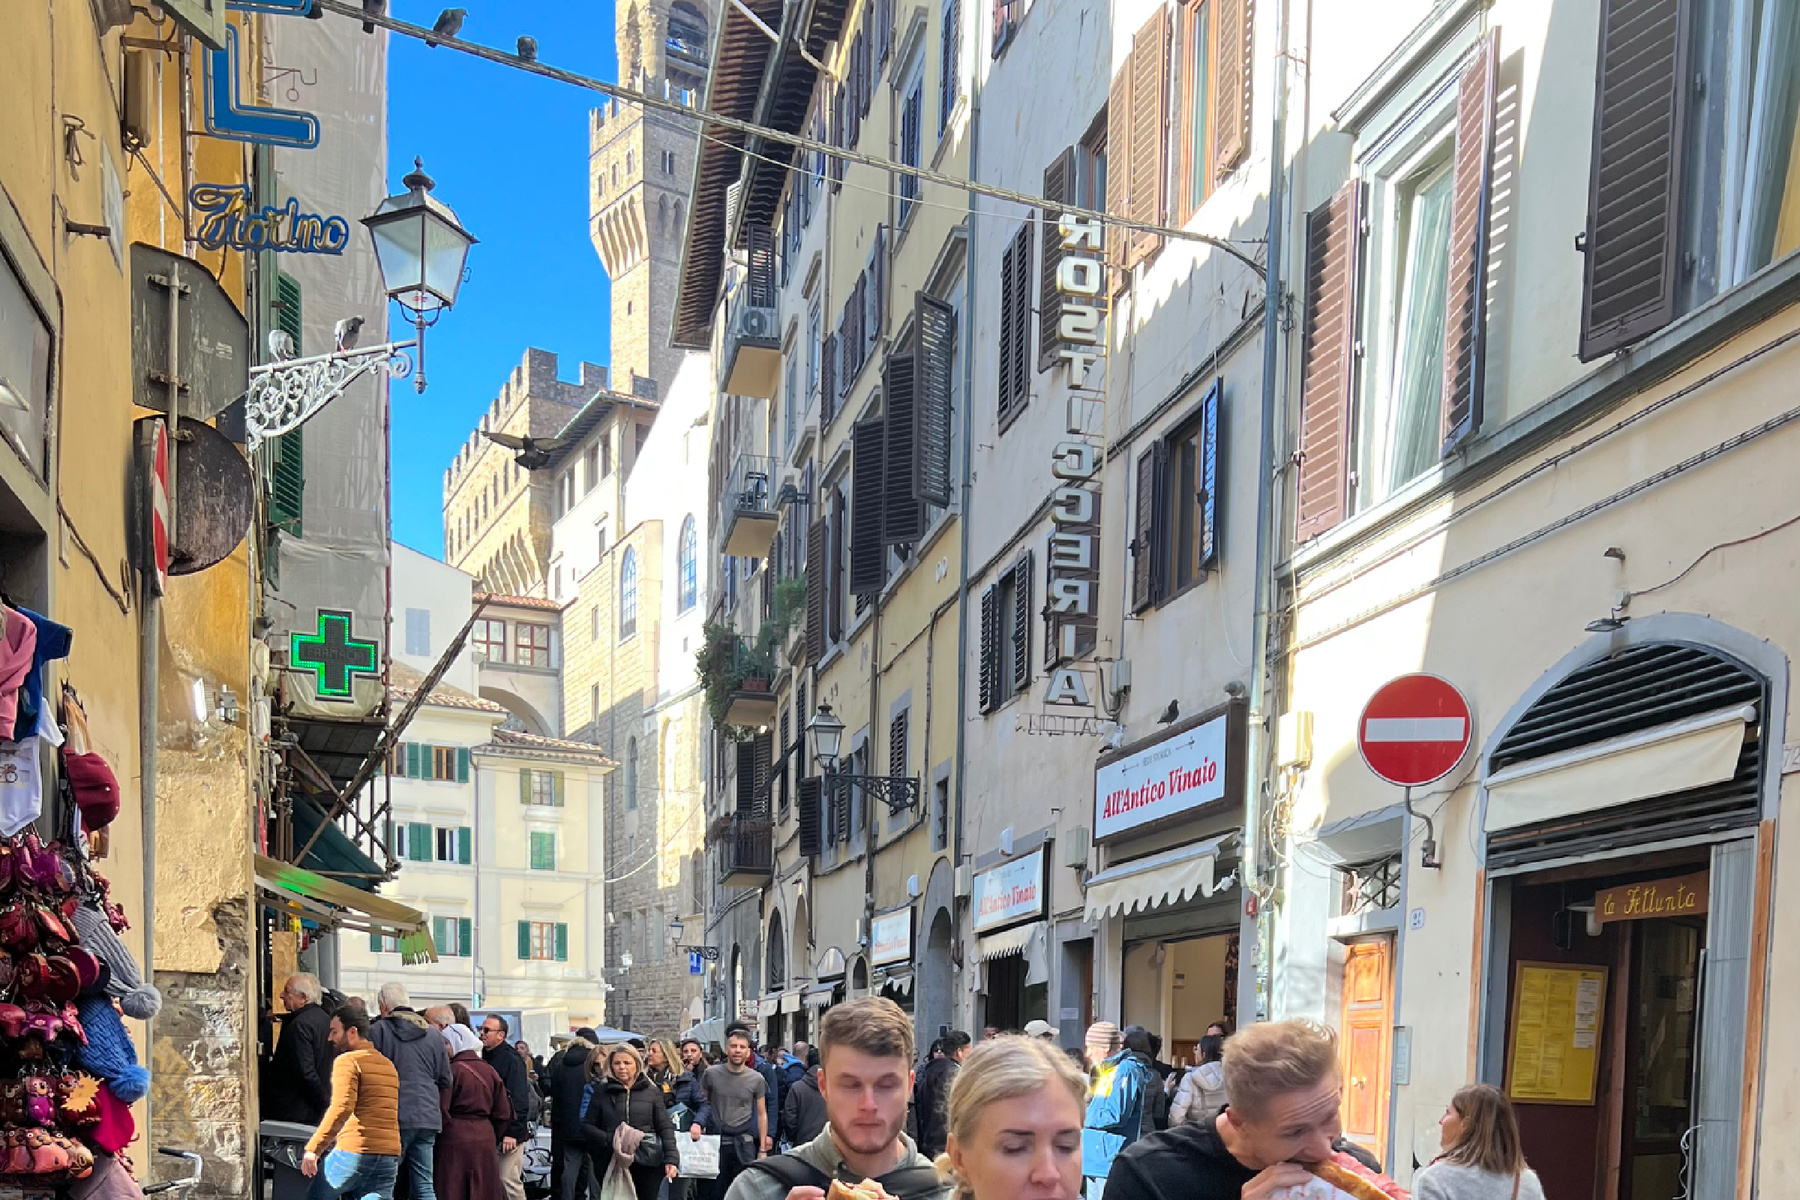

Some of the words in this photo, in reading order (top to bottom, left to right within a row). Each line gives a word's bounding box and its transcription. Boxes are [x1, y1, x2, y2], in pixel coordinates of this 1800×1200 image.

[190, 184, 349, 256] Fiorino
[1102, 778, 1166, 820] All'Antico
[1168, 755, 1218, 797] Vinaio
[1012, 880, 1037, 907] Vinaio
